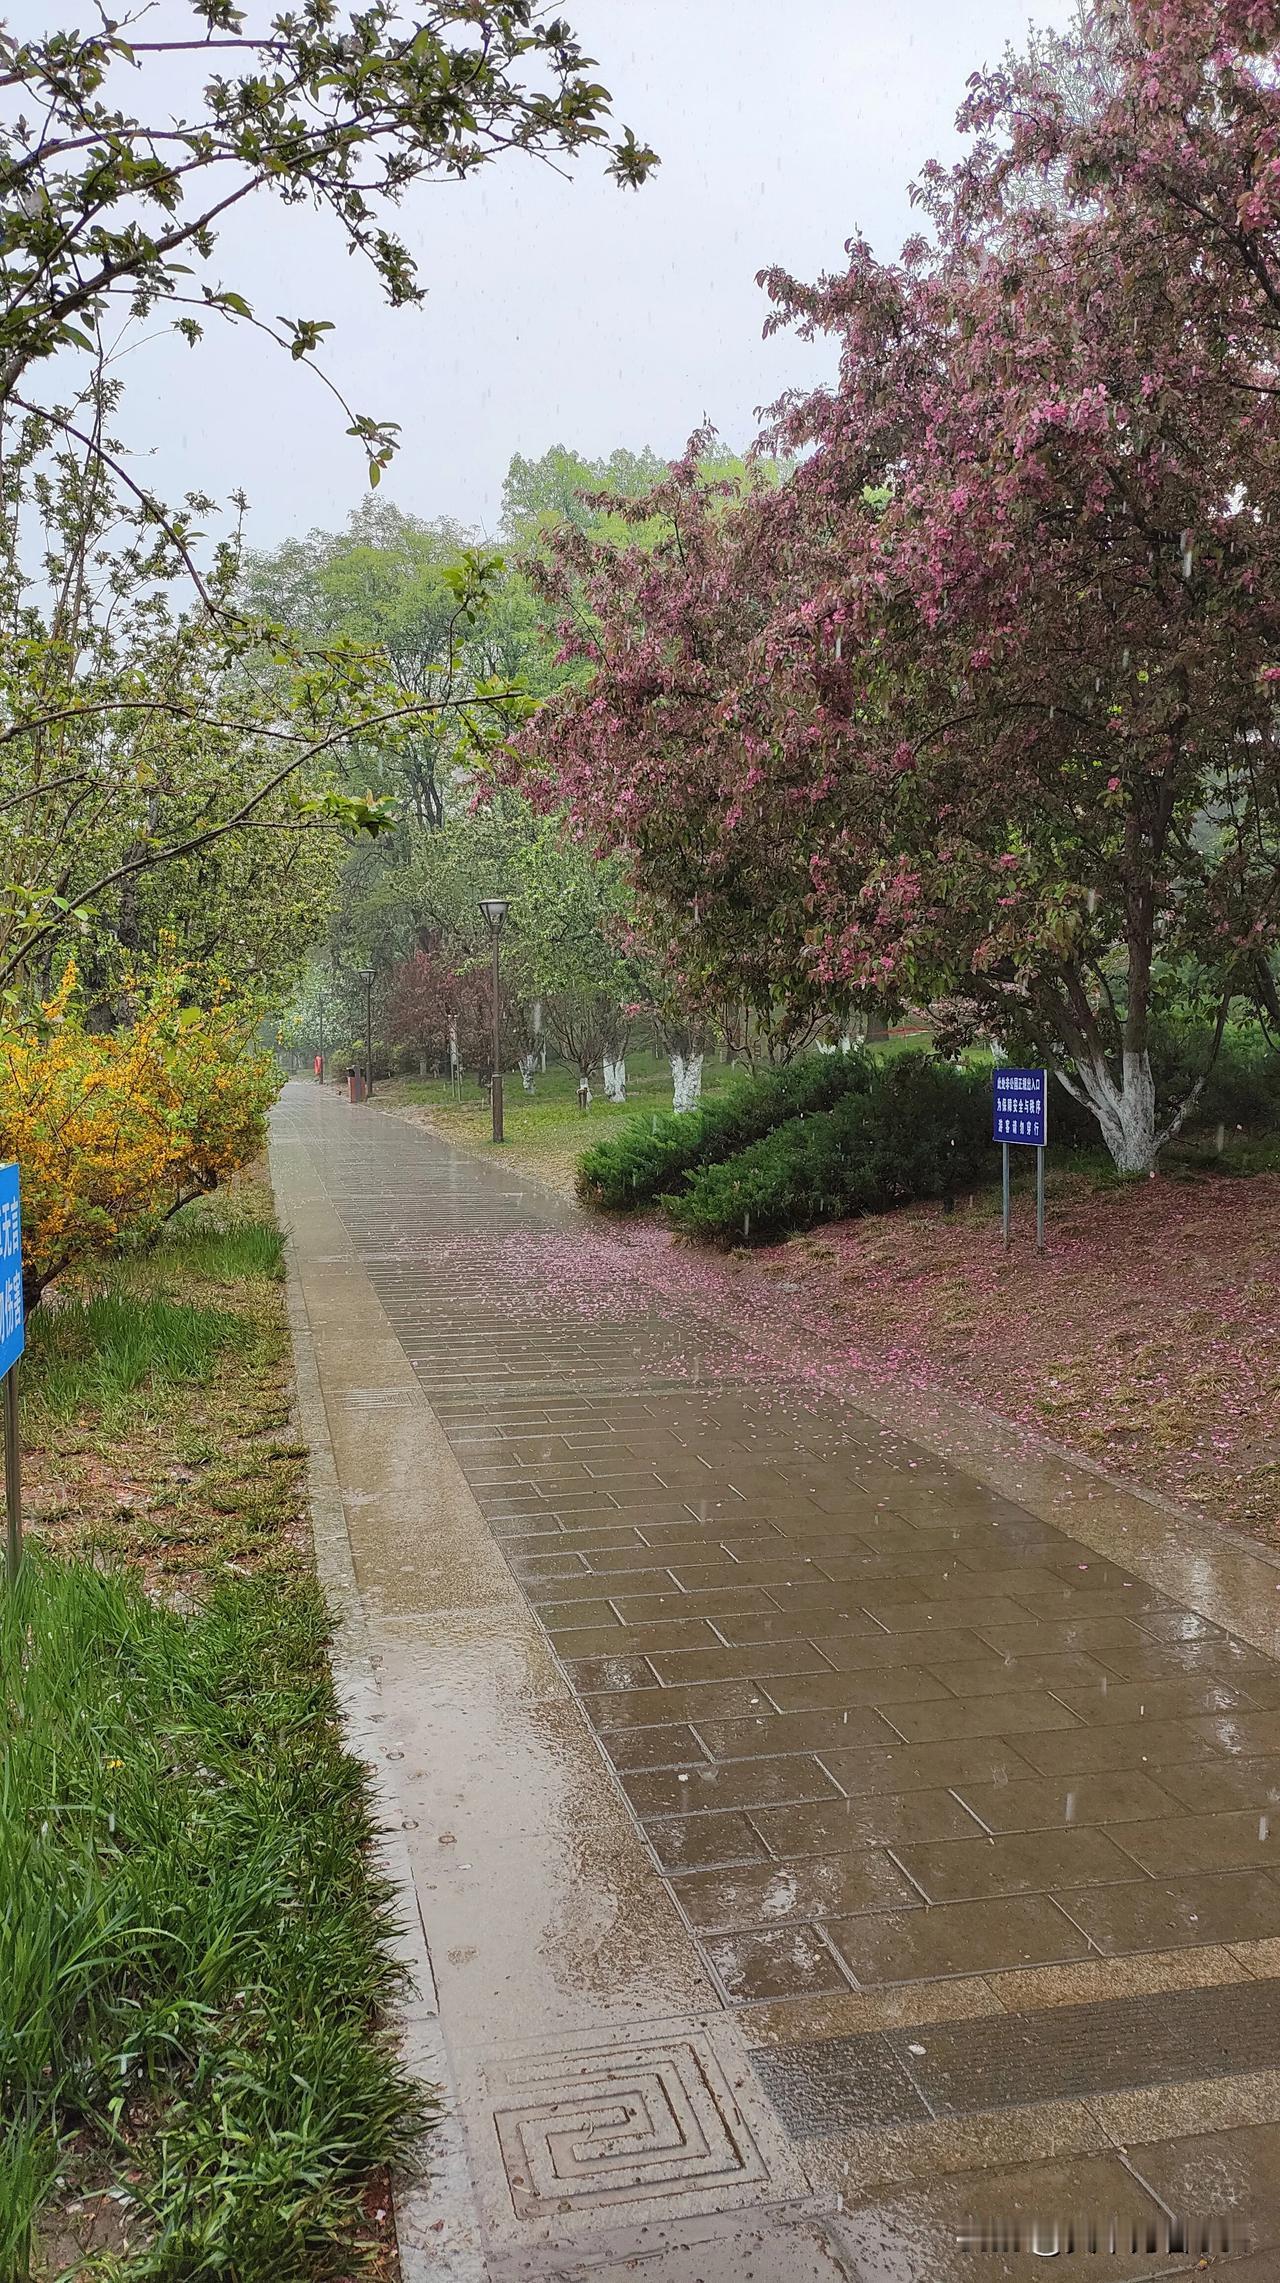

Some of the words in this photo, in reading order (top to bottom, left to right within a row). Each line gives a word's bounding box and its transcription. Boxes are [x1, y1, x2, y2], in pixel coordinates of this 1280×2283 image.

[997, 1099, 1041, 1115] 为保障安全与秩序
[998, 1119, 1040, 1137] 游客请勿穿行
[0, 1195, 19, 1261] 无言
